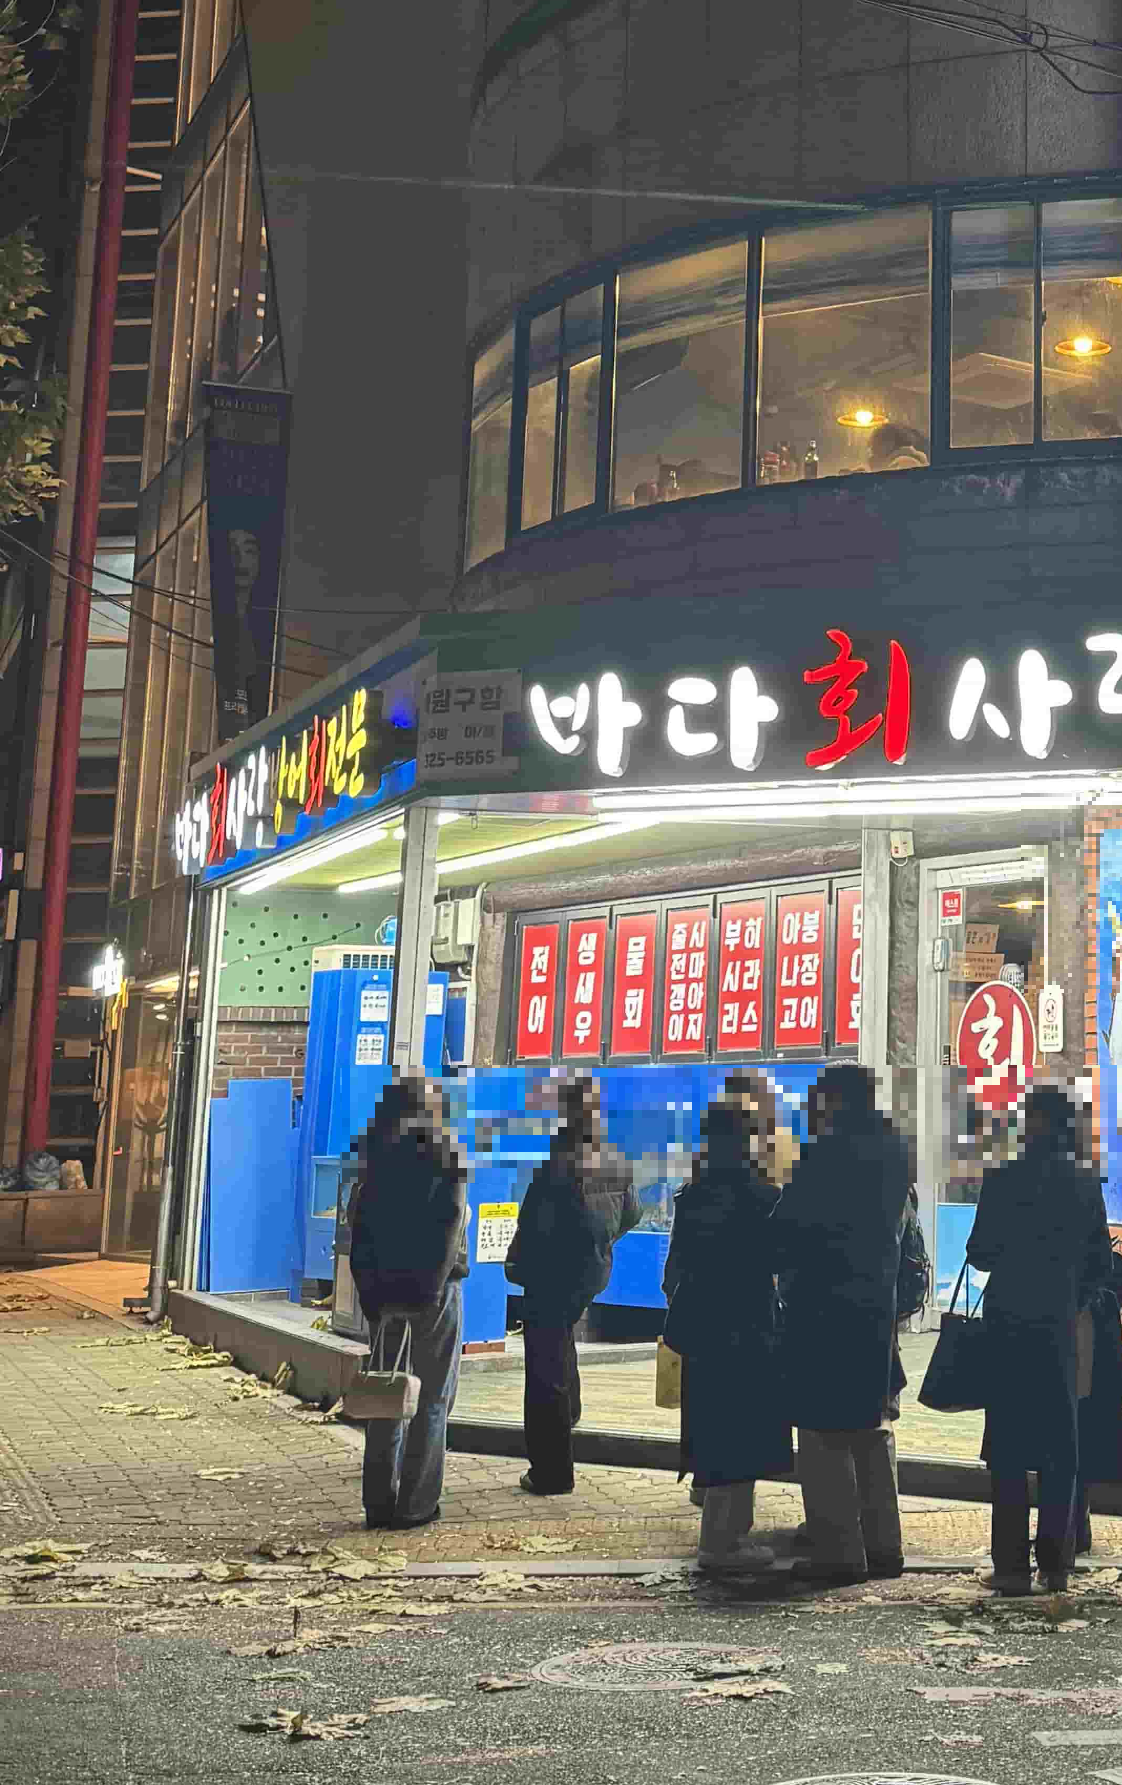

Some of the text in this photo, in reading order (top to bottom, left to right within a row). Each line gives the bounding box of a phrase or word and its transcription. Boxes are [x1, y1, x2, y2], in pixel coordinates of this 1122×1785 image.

[426, 685, 502, 714] 원구함
[424, 749, 495, 769] 25-6565
[527, 945, 550, 1034] 전어
[573, 932, 597, 1044] 생새우
[622, 936, 646, 1029] 물회
[668, 923, 687, 1042] 줄전갱이
[686, 920, 707, 1041] 시마아지
[722, 919, 741, 1034] 부시리
[741, 916, 762, 1032] 히라스
[779, 912, 801, 1030] 아나고
[799, 910, 820, 1029] 붕장어
